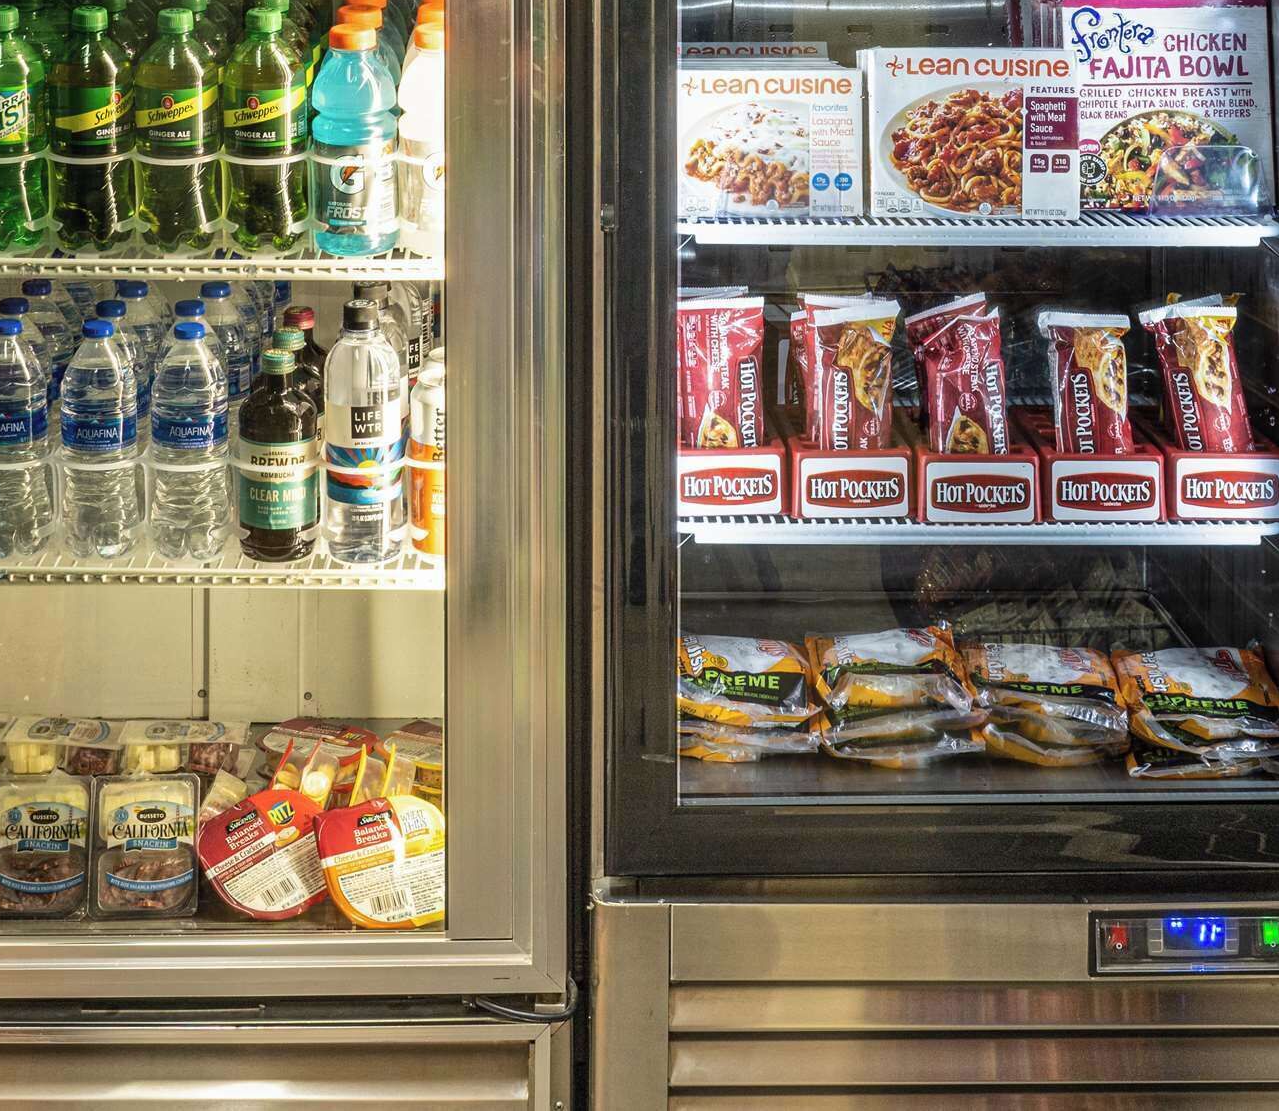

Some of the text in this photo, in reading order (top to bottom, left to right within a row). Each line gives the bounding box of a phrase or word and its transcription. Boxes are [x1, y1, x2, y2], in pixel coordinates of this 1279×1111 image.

[1164, 32, 1248, 53] CHICKEN
[906, 57, 1070, 78] Lean cuisine
[1089, 54, 1250, 80] FAJITA BOWL
[700, 77, 853, 95] Lean cuisine
[1030, 86, 1076, 95] FEATURES
[1079, 87, 1252, 99] GRILLED CHICKEN BREAST WITH
[1030, 100, 1067, 113] Spaghetti
[1078, 99, 1120, 109] CHIPOTLE
[1121, 99, 1156, 110] FAJITA
[1192, 98, 1227, 109] GRAIN
[146, 102, 195, 126] Schweppes
[233, 103, 280, 127] Schweppes
[1029, 112, 1067, 123] with Meat
[1080, 110, 1128, 120] BLACK BEANS
[1212, 108, 1252, 118] PEPPERS
[148, 129, 191, 140] GINGER ALE
[1030, 124, 1054, 134] Sauce
[354, 410, 382, 422] LIFE
[75, 426, 120, 441] AQUAFINA
[354, 422, 382, 434] WTR
[249, 486, 281, 501] CLEAR
[683, 473, 773, 499] HOT POCKETS
[810, 476, 900, 500] HOT POCKETS
[936, 482, 1026, 506] HOT POCKETS
[31, 813, 58, 822] BUSSETO
[267, 802, 297, 826] RITZ
[4, 823, 82, 841] CALIFORNIA
[225, 819, 265, 845] Balanced
[228, 830, 261, 851] Breaks
[213, 841, 266, 874] Cheese Crackers
